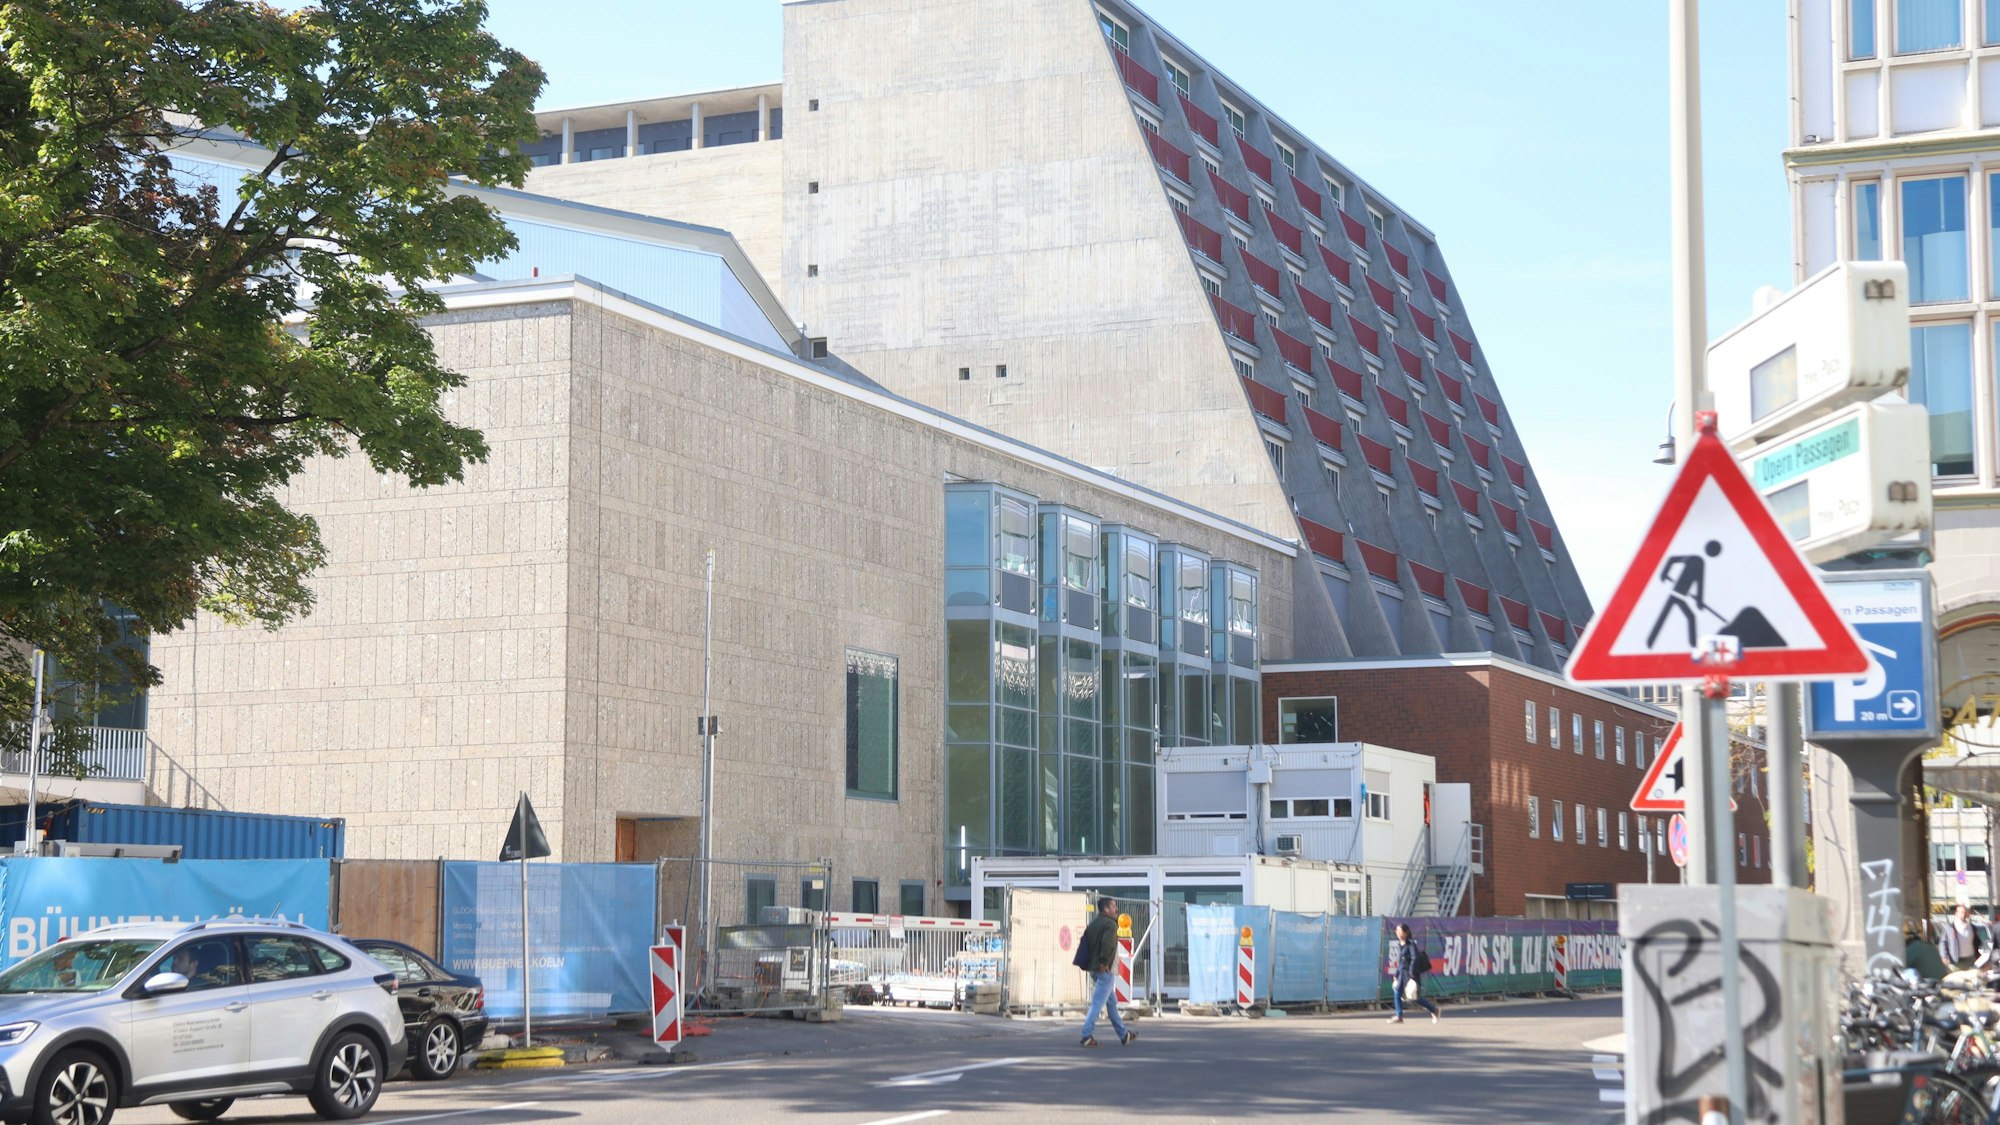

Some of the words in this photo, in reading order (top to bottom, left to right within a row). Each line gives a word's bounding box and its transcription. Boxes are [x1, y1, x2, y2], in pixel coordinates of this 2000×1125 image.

[1763, 452, 1793, 485] Opern
[1795, 430, 1850, 466] Passagen
[1855, 605, 1918, 617] Passagen
[1860, 711, 1875, 721] 20
[1876, 713, 1889, 721] m
[1492, 934, 1516, 975] SPL
[452, 956, 565, 971] WWW.BUEHNE.KOELN
